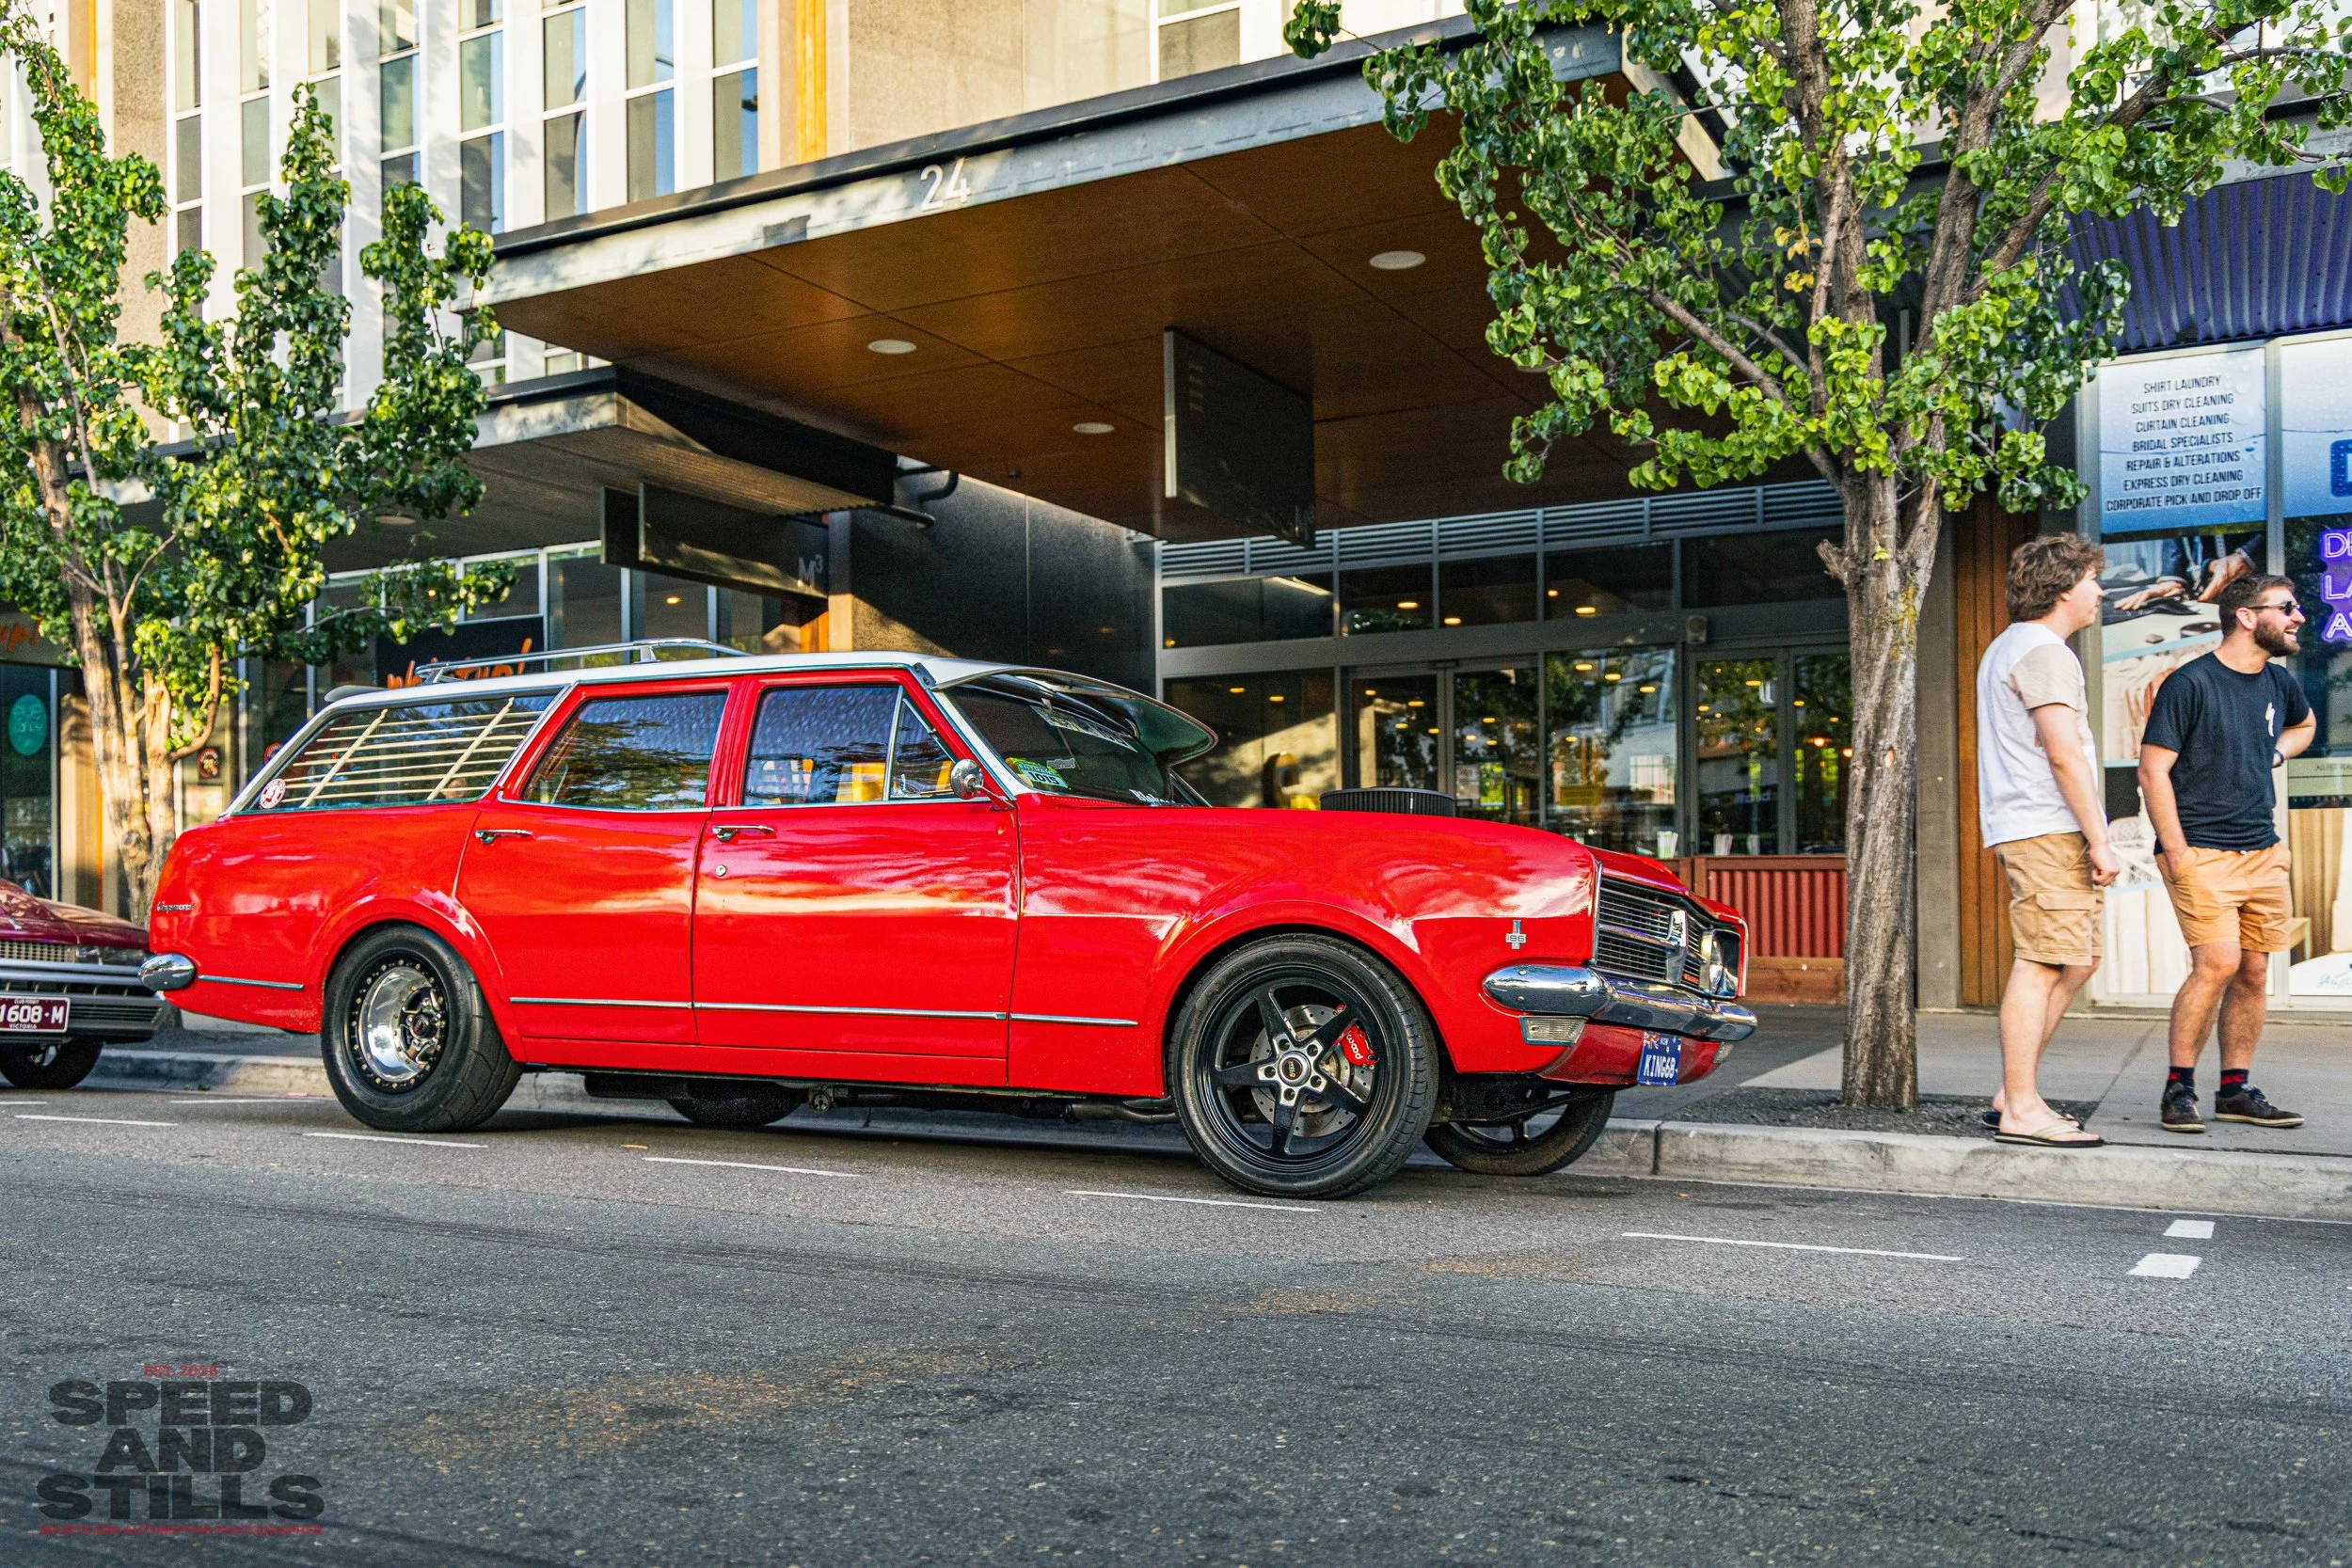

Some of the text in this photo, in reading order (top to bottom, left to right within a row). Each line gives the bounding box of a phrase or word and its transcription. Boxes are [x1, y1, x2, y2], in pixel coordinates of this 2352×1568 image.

[920, 157, 971, 212] 24
[2143, 375, 2221, 394] SHIRT LAUNDRY
[2132, 393, 2234, 415] SUITS DRY CLEANING
[2136, 413, 2231, 434] CURTAIN CLEANING
[2133, 432, 2233, 452] BRIDAL SPECIALISTS
[2126, 451, 2241, 471] REPAIR & ALTERATIONS
[2122, 469, 2244, 492] EXPRESS DRY CLEANING
[2106, 486, 2263, 512] CORPORATE PICK AND DROP OFF
[1028, 771, 1060, 785] 1015
[1507, 934, 1525, 942] 186
